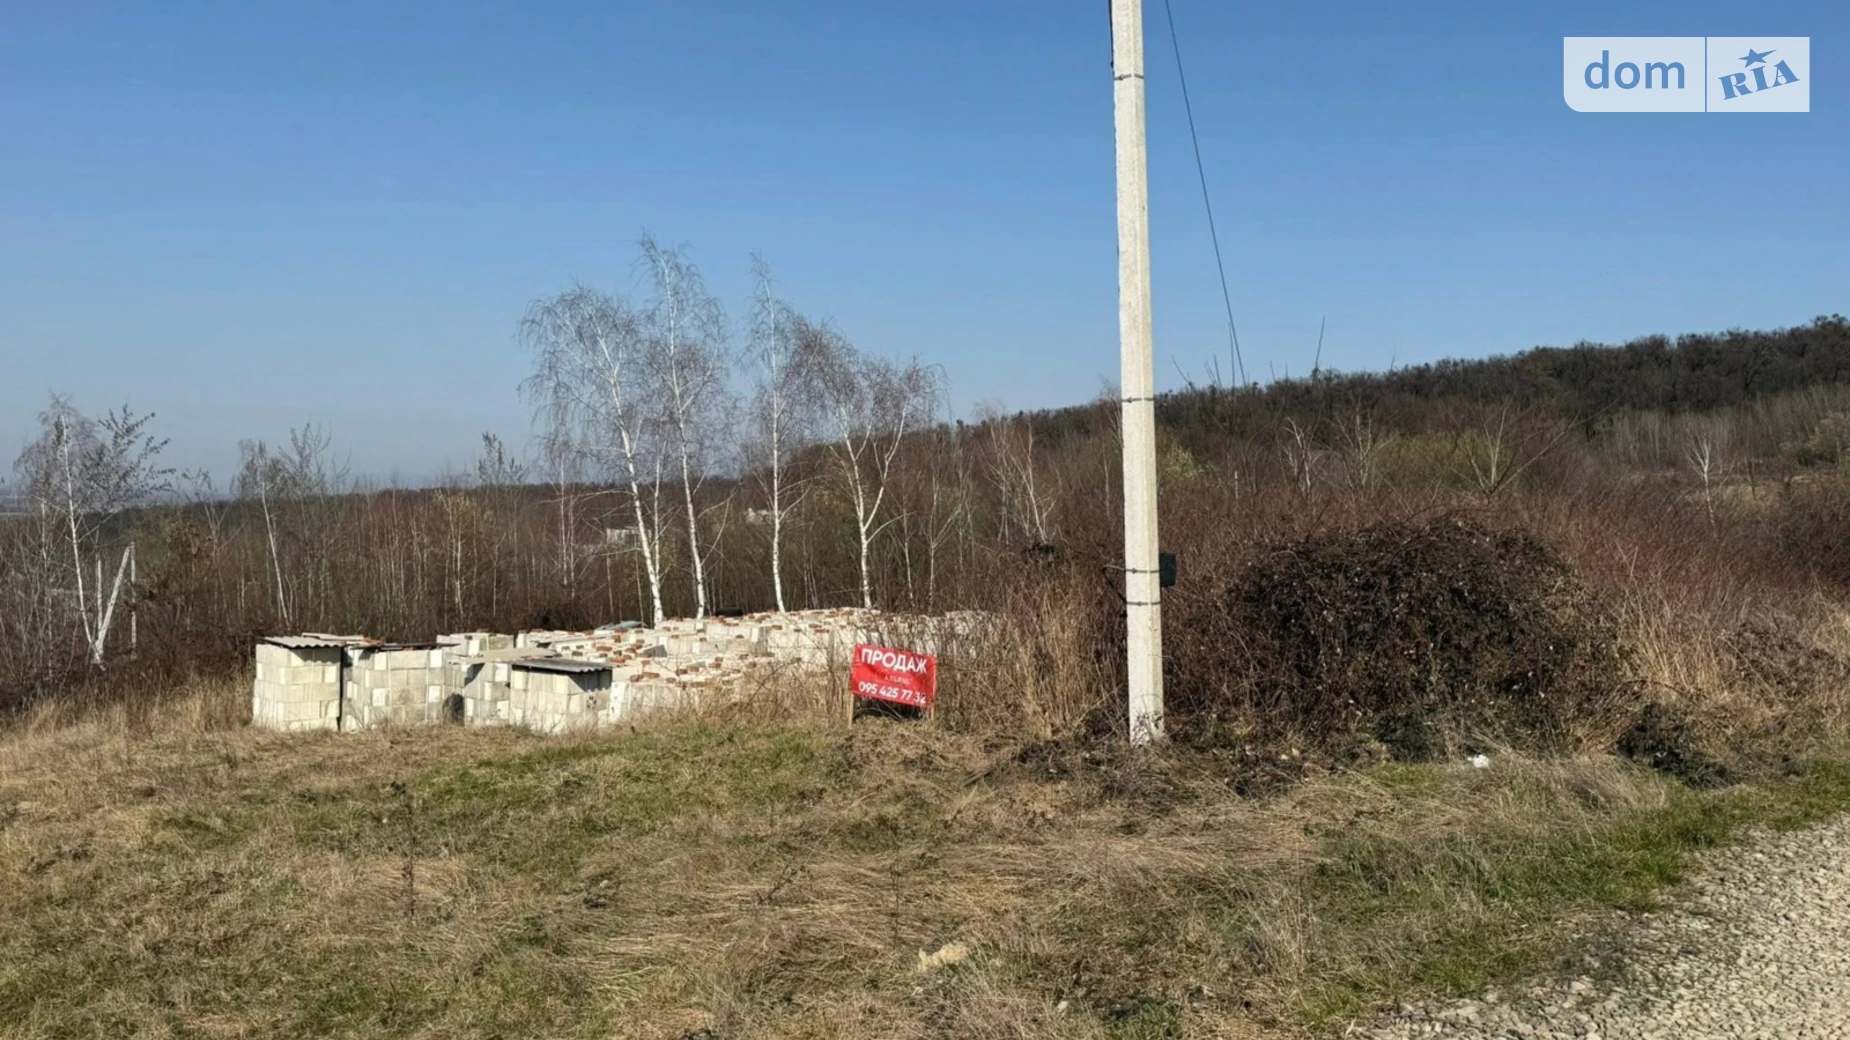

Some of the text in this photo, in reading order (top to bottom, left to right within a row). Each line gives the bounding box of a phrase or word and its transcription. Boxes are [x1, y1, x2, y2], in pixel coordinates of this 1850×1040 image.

[862, 648, 927, 673] ПРОДАЖ
[858, 681, 878, 694] 095
[880, 686, 899, 698] 425
[901, 689, 913, 700] 77
